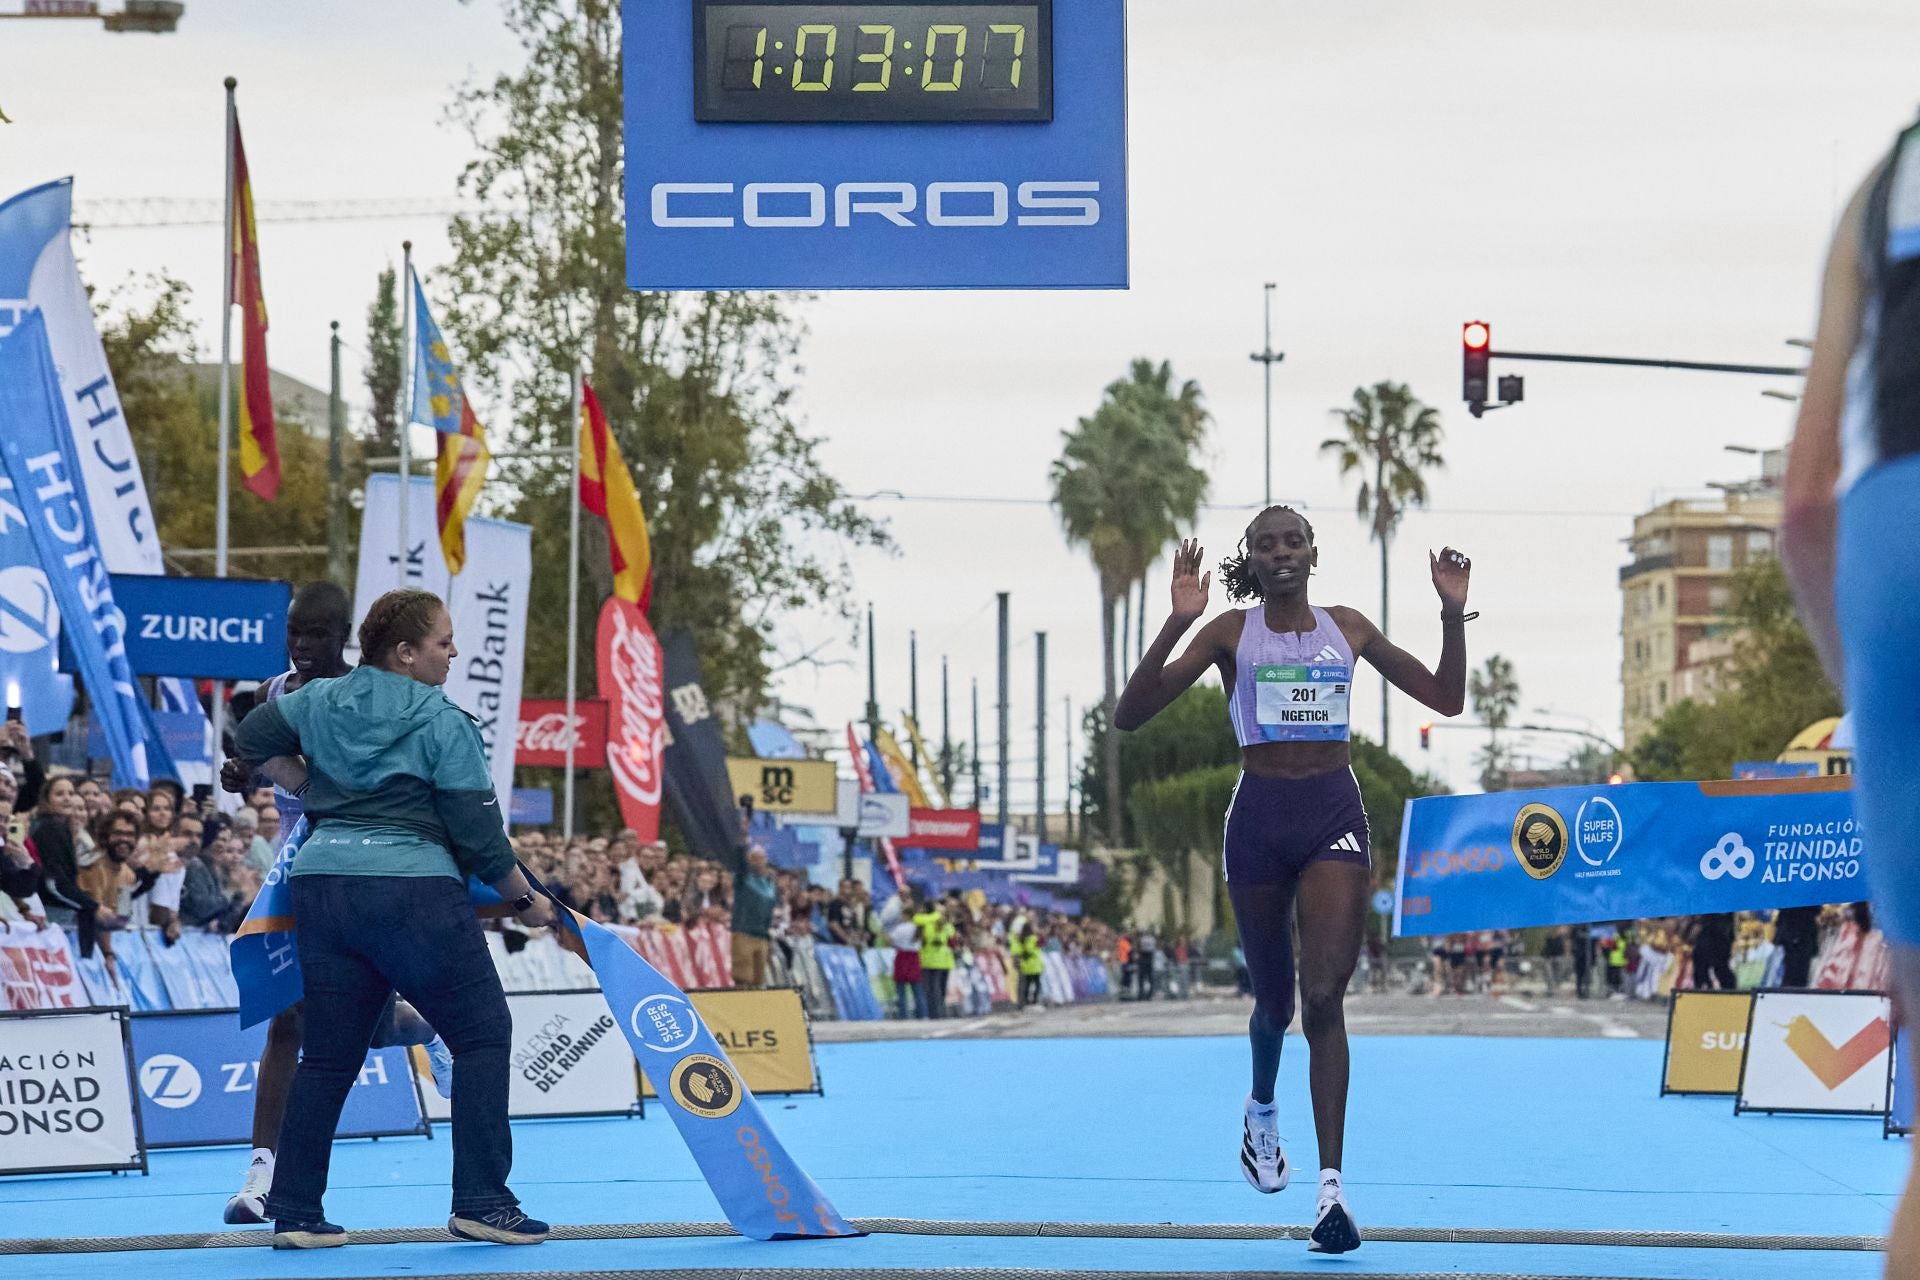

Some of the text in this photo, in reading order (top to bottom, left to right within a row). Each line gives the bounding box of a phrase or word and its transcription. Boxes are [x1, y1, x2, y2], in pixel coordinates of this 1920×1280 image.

[750, 24, 1026, 91] 1:03:07
[651, 181, 1100, 227] COROS
[139, 613, 265, 644] ZURICH
[1291, 688, 1317, 702] 201
[1281, 710, 1329, 722] NGETICH
[1583, 820, 1615, 832] SUPER
[1583, 832, 1614, 844] HALFS
[1764, 838, 1863, 861] TRINIDAD
[1761, 860, 1859, 883] ALFONSO
[647, 1006, 674, 1043] SUPER
[657, 1003, 684, 1039] HALFS
[510, 1014, 570, 1069] VALENCIA
[714, 1030, 777, 1048] ALFS
[523, 1034, 571, 1081] CIUDAD
[535, 1015, 614, 1093] DEL RUNNING
[0, 1077, 100, 1105] IDAD
